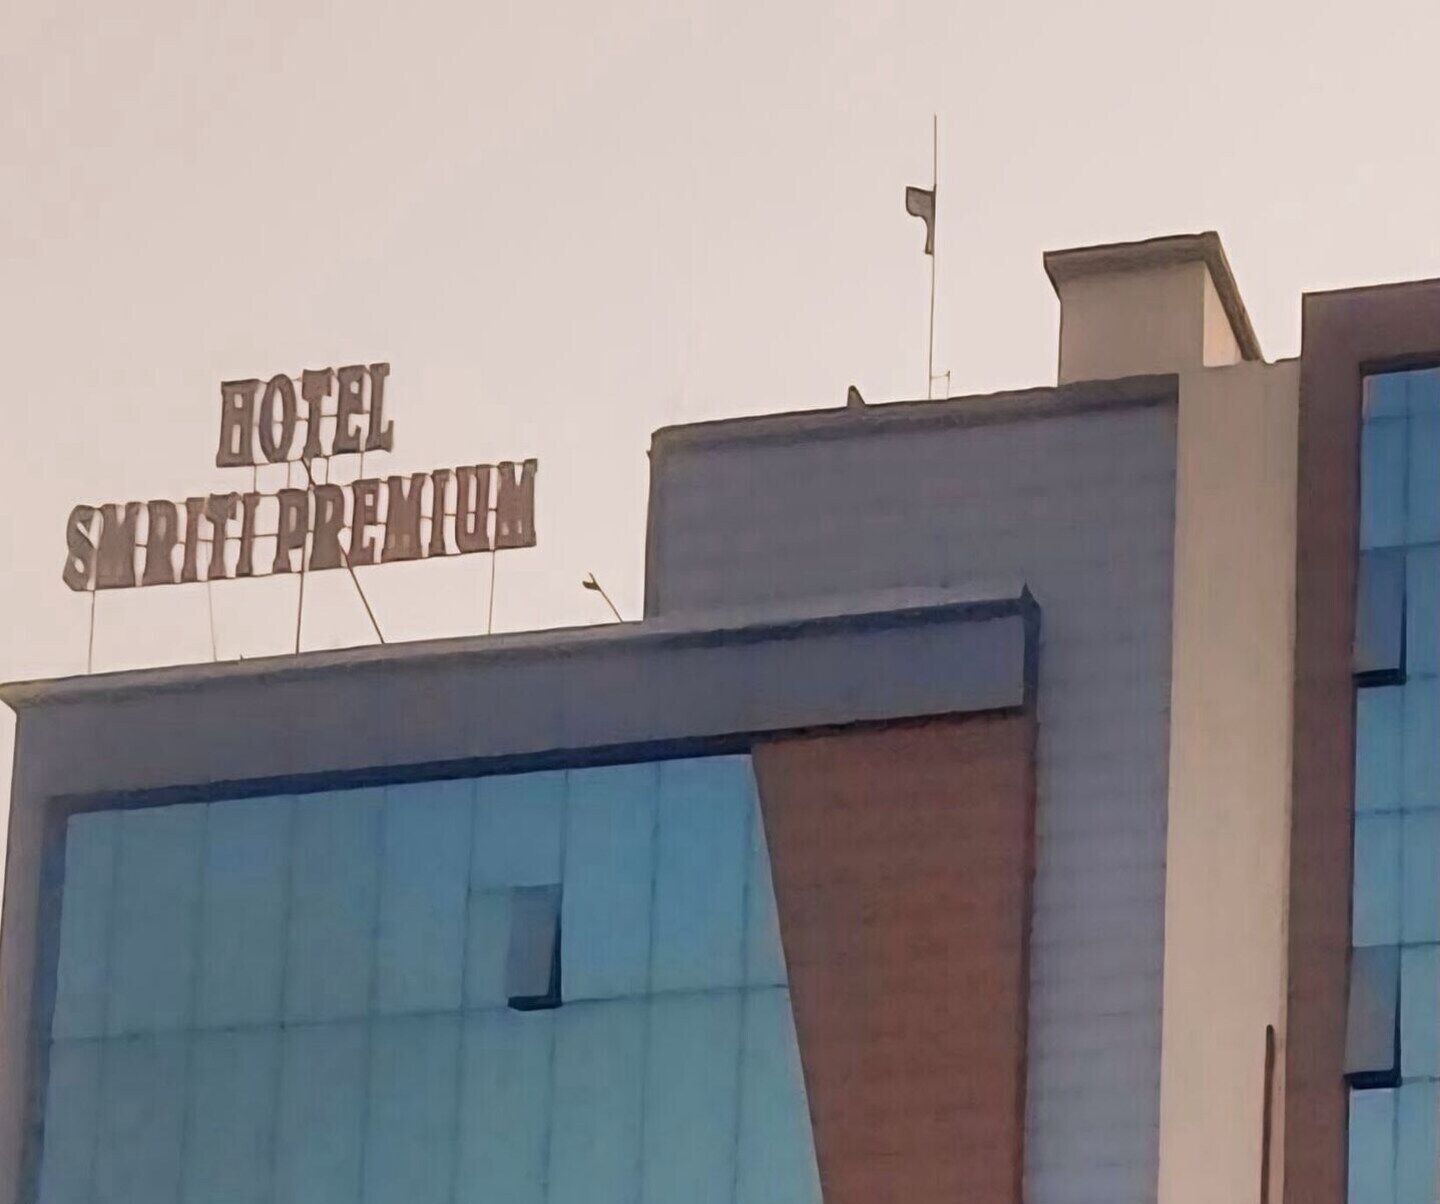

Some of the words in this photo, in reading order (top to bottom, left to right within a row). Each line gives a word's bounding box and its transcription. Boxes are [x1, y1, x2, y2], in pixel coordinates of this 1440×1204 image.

[215, 362, 394, 468] HOTEL
[62, 491, 264, 591] SMRITI
[272, 458, 539, 574] PREMIUM
